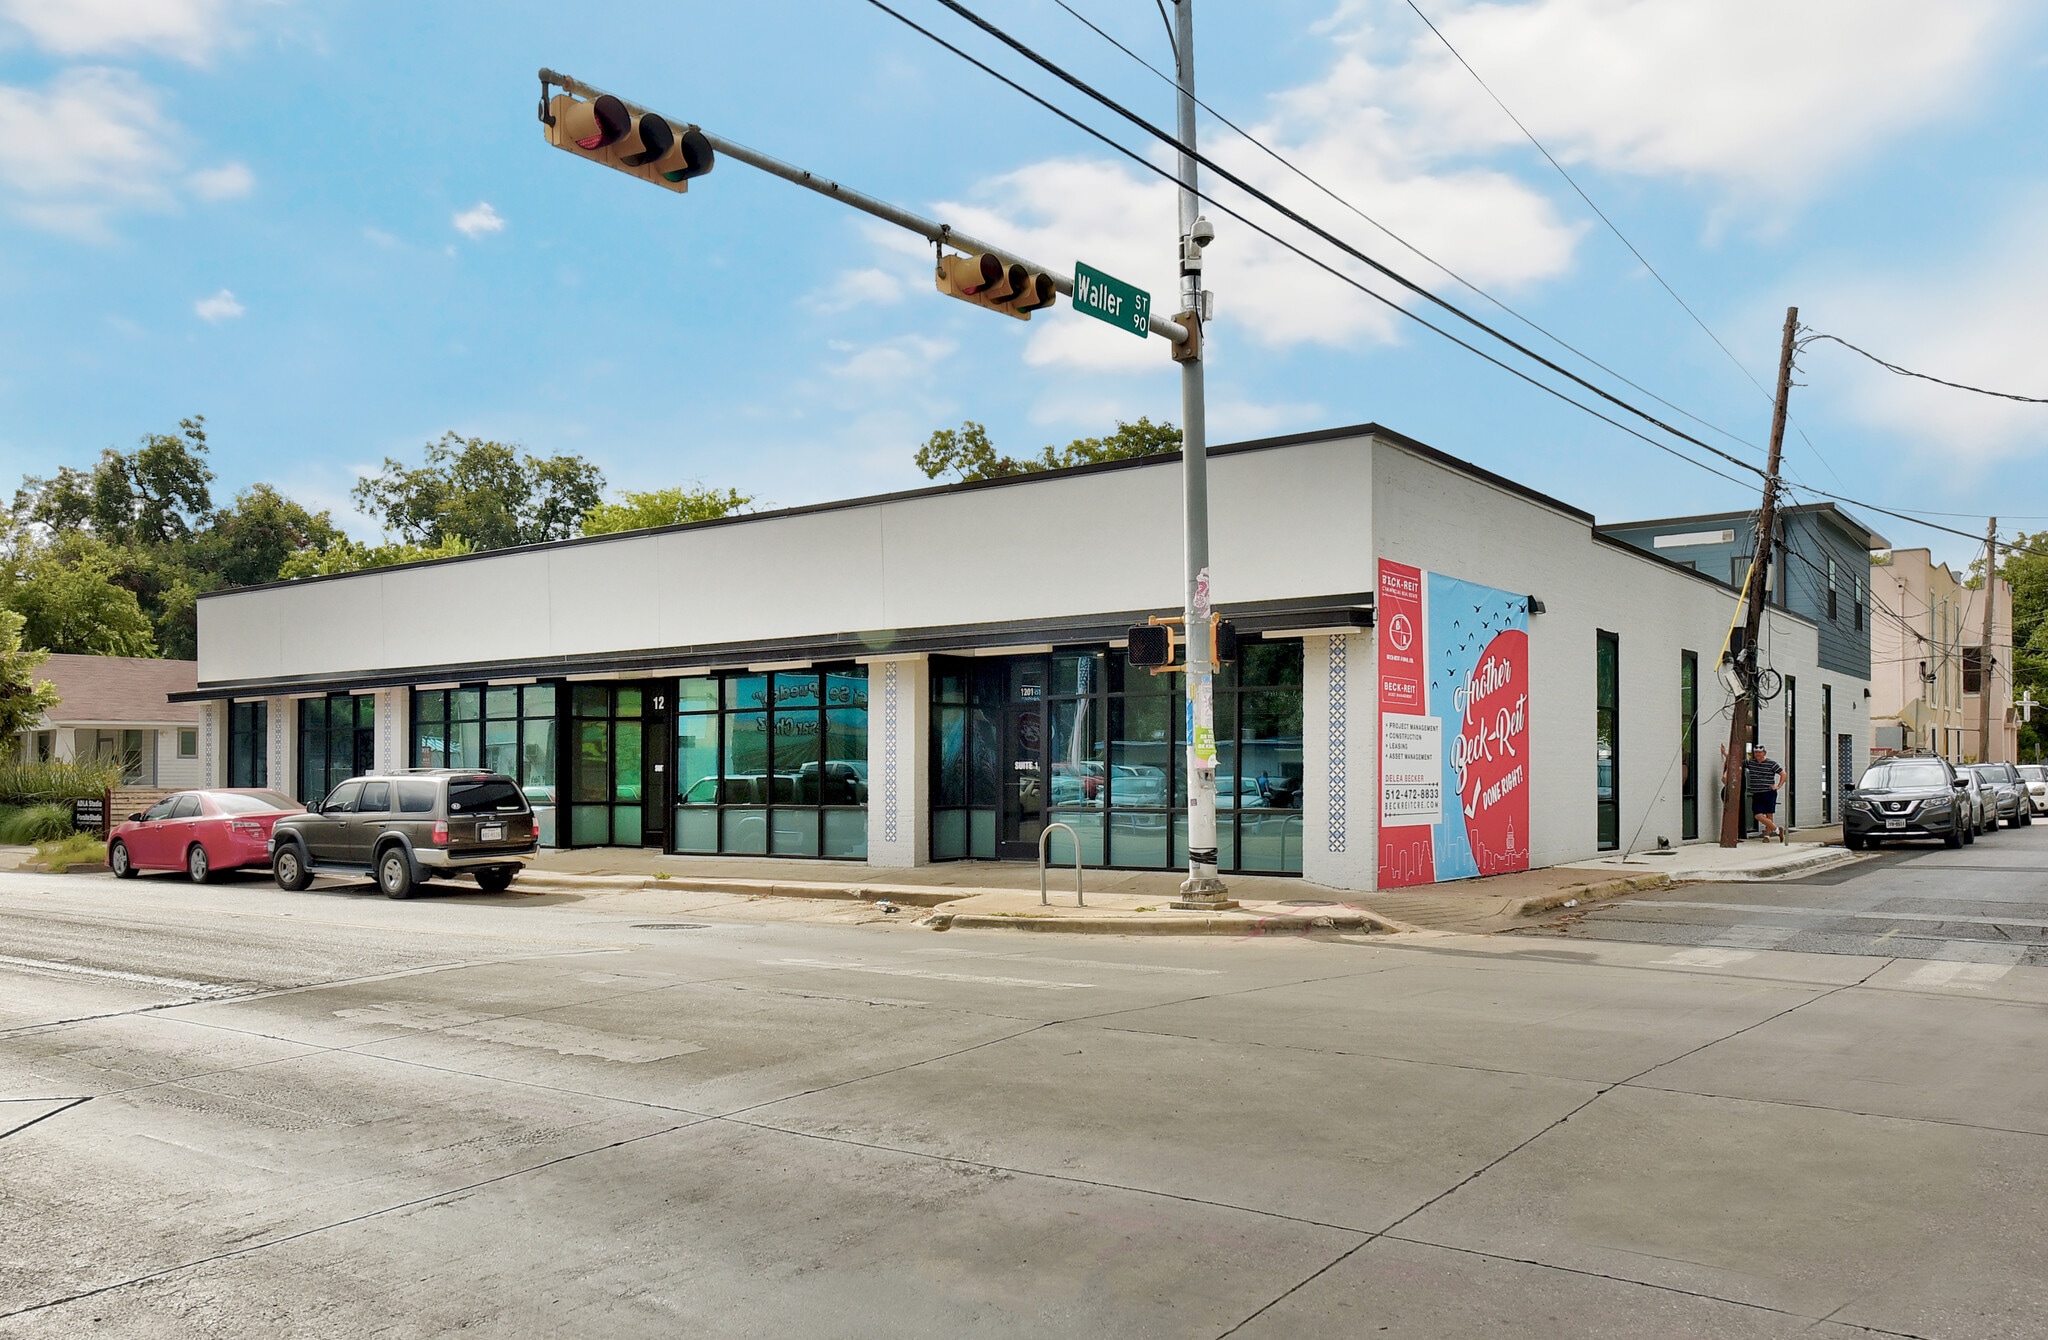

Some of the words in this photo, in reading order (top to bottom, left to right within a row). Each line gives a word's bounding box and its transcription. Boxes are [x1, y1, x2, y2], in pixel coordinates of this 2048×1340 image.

[1078, 272, 1123, 316] Waller
[1135, 294, 1148, 312] ST
[1133, 314, 1147, 332] 90
[1381, 574, 1419, 593] BECK-REIT
[1021, 688, 1033, 696] 1201
[1383, 681, 1416, 694] BECK-REIT
[1453, 655, 1512, 726] Another
[653, 695, 665, 710] 12
[1389, 722, 1409, 730] PROJECT
[1410, 724, 1439, 732] MANAGEMENT
[1389, 732, 1422, 740] CONSTRUCTION
[1389, 742, 1408, 750] LEASING
[1450, 694, 1528, 797] Beck-Reit
[1014, 761, 1033, 770] SUITE
[1385, 774, 1403, 782] DELEA
[1404, 774, 1424, 782] BECKER
[1385, 788, 1439, 800] 512-472-8833
[1482, 781, 1501, 811] DONE
[1501, 764, 1523, 797] RIGHT!
